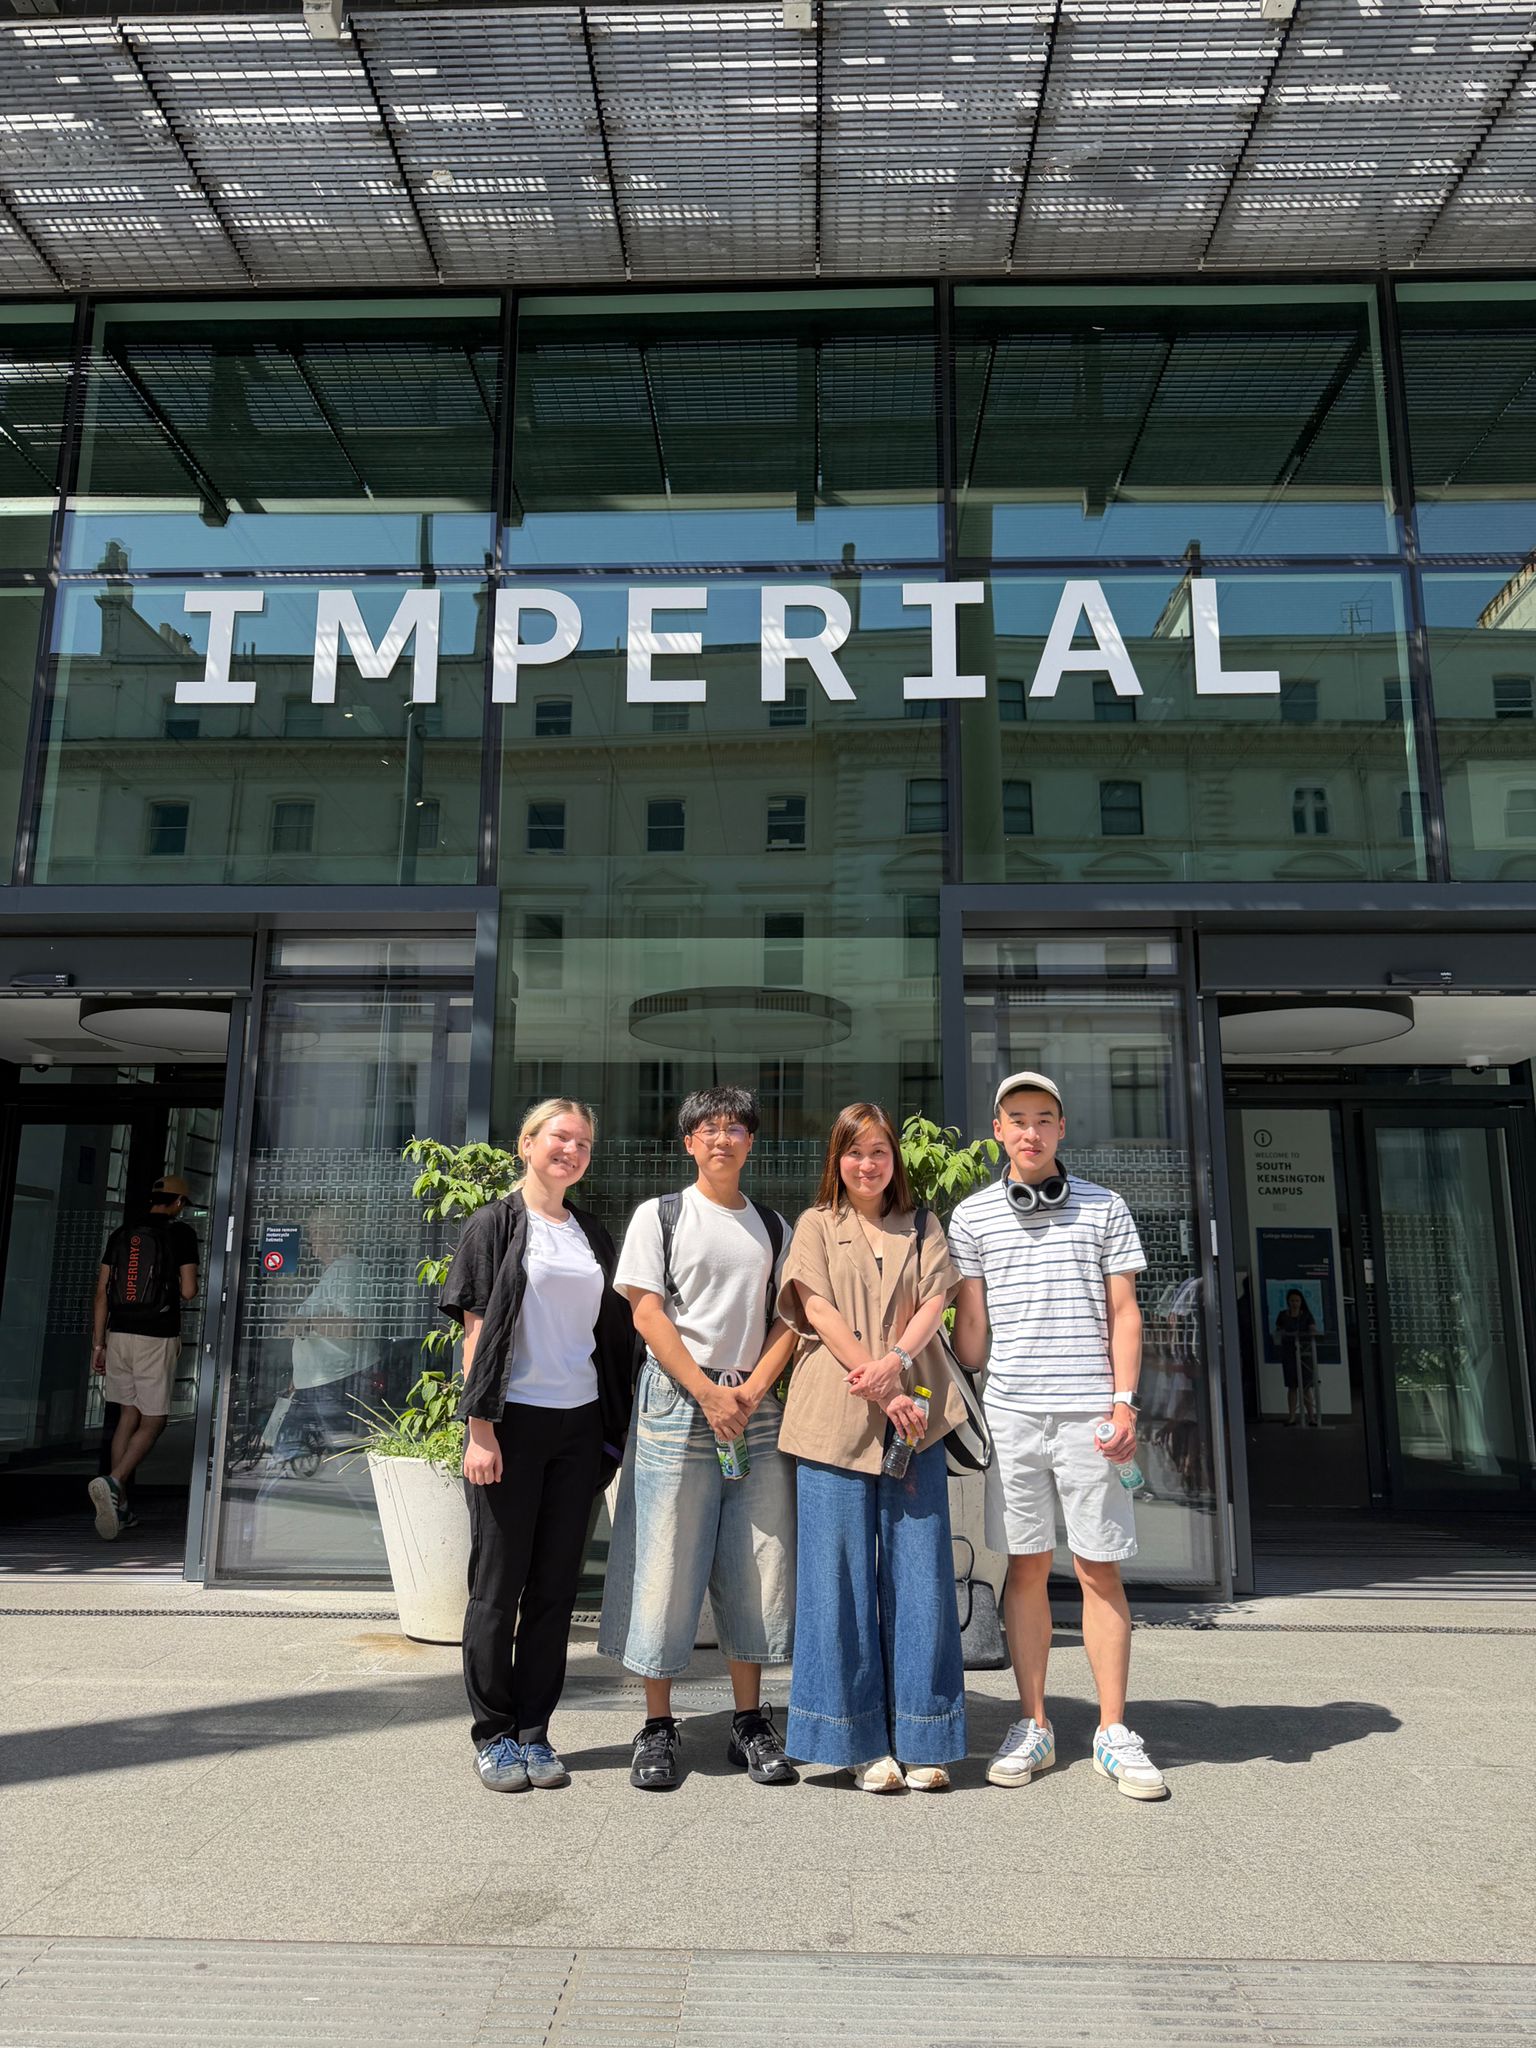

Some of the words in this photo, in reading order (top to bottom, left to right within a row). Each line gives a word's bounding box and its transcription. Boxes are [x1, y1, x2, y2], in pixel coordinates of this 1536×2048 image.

[175, 578, 1281, 704] IMPERIAL
[1256, 1162, 1292, 1171] SOUTH
[1257, 1174, 1325, 1183] KENSINGTON
[1258, 1187, 1303, 1195] CAMPUS
[126, 1246, 140, 1302] SUPERDRY
